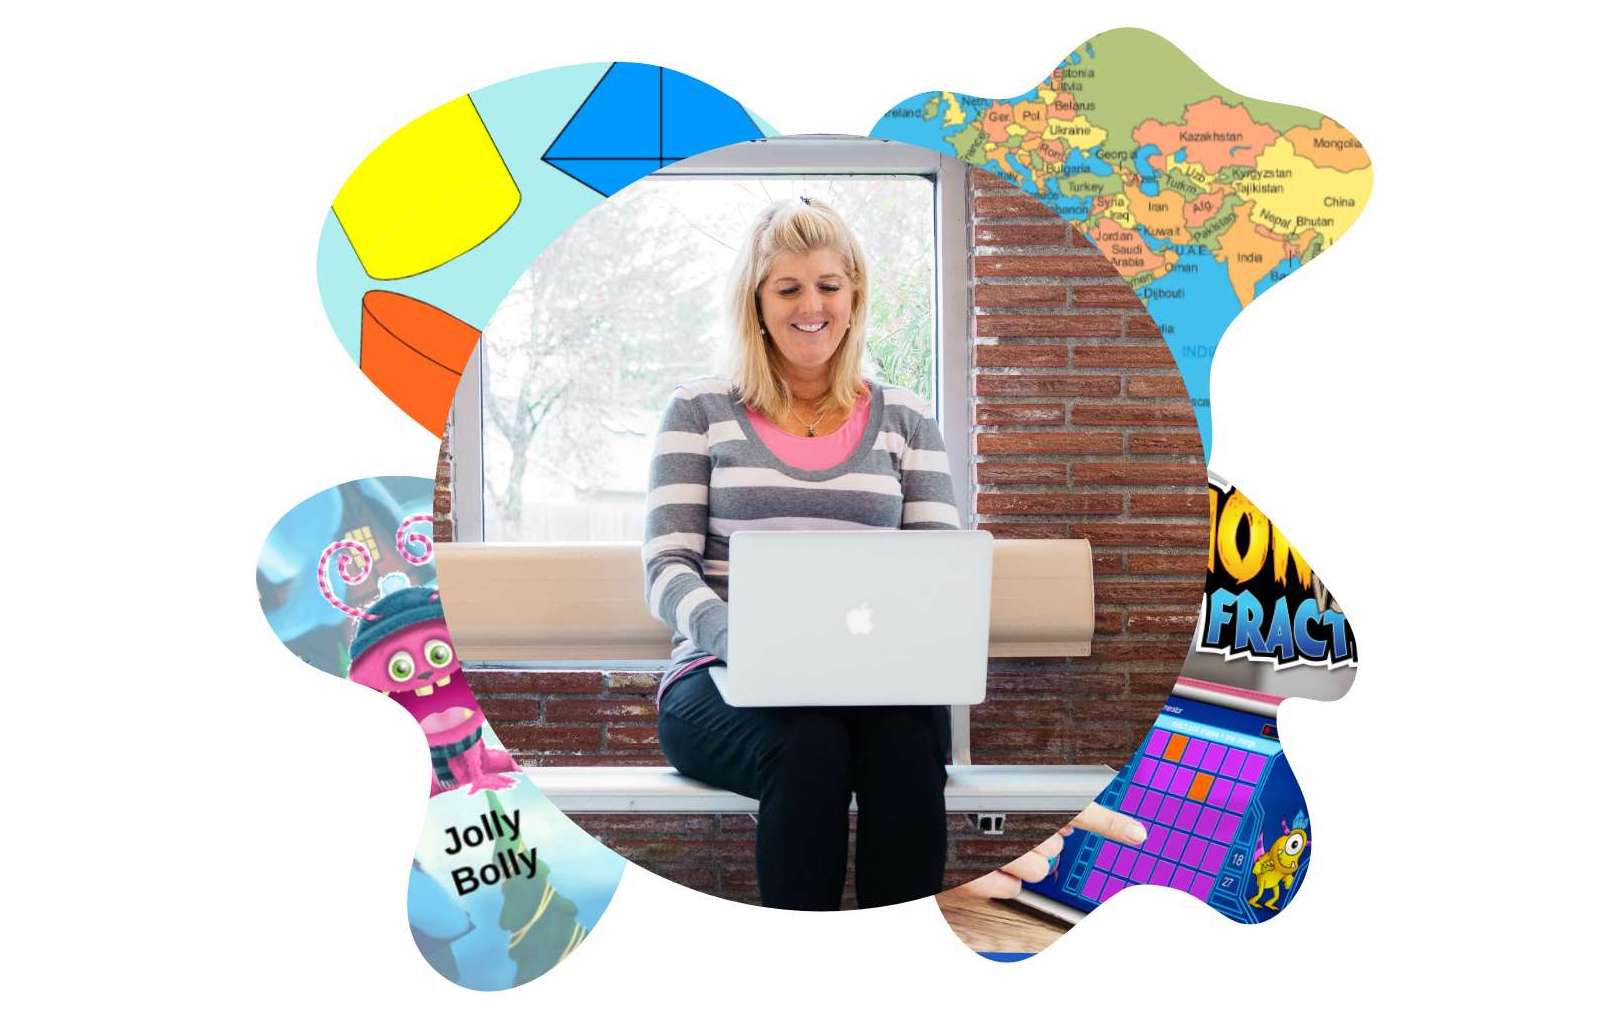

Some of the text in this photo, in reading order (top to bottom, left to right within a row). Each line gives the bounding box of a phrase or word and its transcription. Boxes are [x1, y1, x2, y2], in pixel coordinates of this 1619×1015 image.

[1055, 101, 1096, 111] Belarus
[1050, 126, 1091, 135] Ukraine
[1179, 131, 1244, 142] Kazakhstan
[1232, 169, 1293, 180] Kyrgyzstan
[1069, 182, 1104, 193] Turkey
[1235, 183, 1285, 195] Tajikistan
[1148, 202, 1169, 212] Iran
[1323, 196, 1356, 207] China
[1259, 207, 1292, 228] Nepal
[1295, 216, 1335, 226] Bhutan
[1111, 244, 1142, 254] Saudi
[1237, 253, 1264, 263] India
[1164, 263, 1200, 273] Oman
[1143, 287, 1185, 300] Djibouti
[1206, 587, 1349, 660] FRACT
[444, 808, 521, 856] Jolly
[1232, 852, 1245, 866] 18
[451, 847, 538, 897] Bolly
